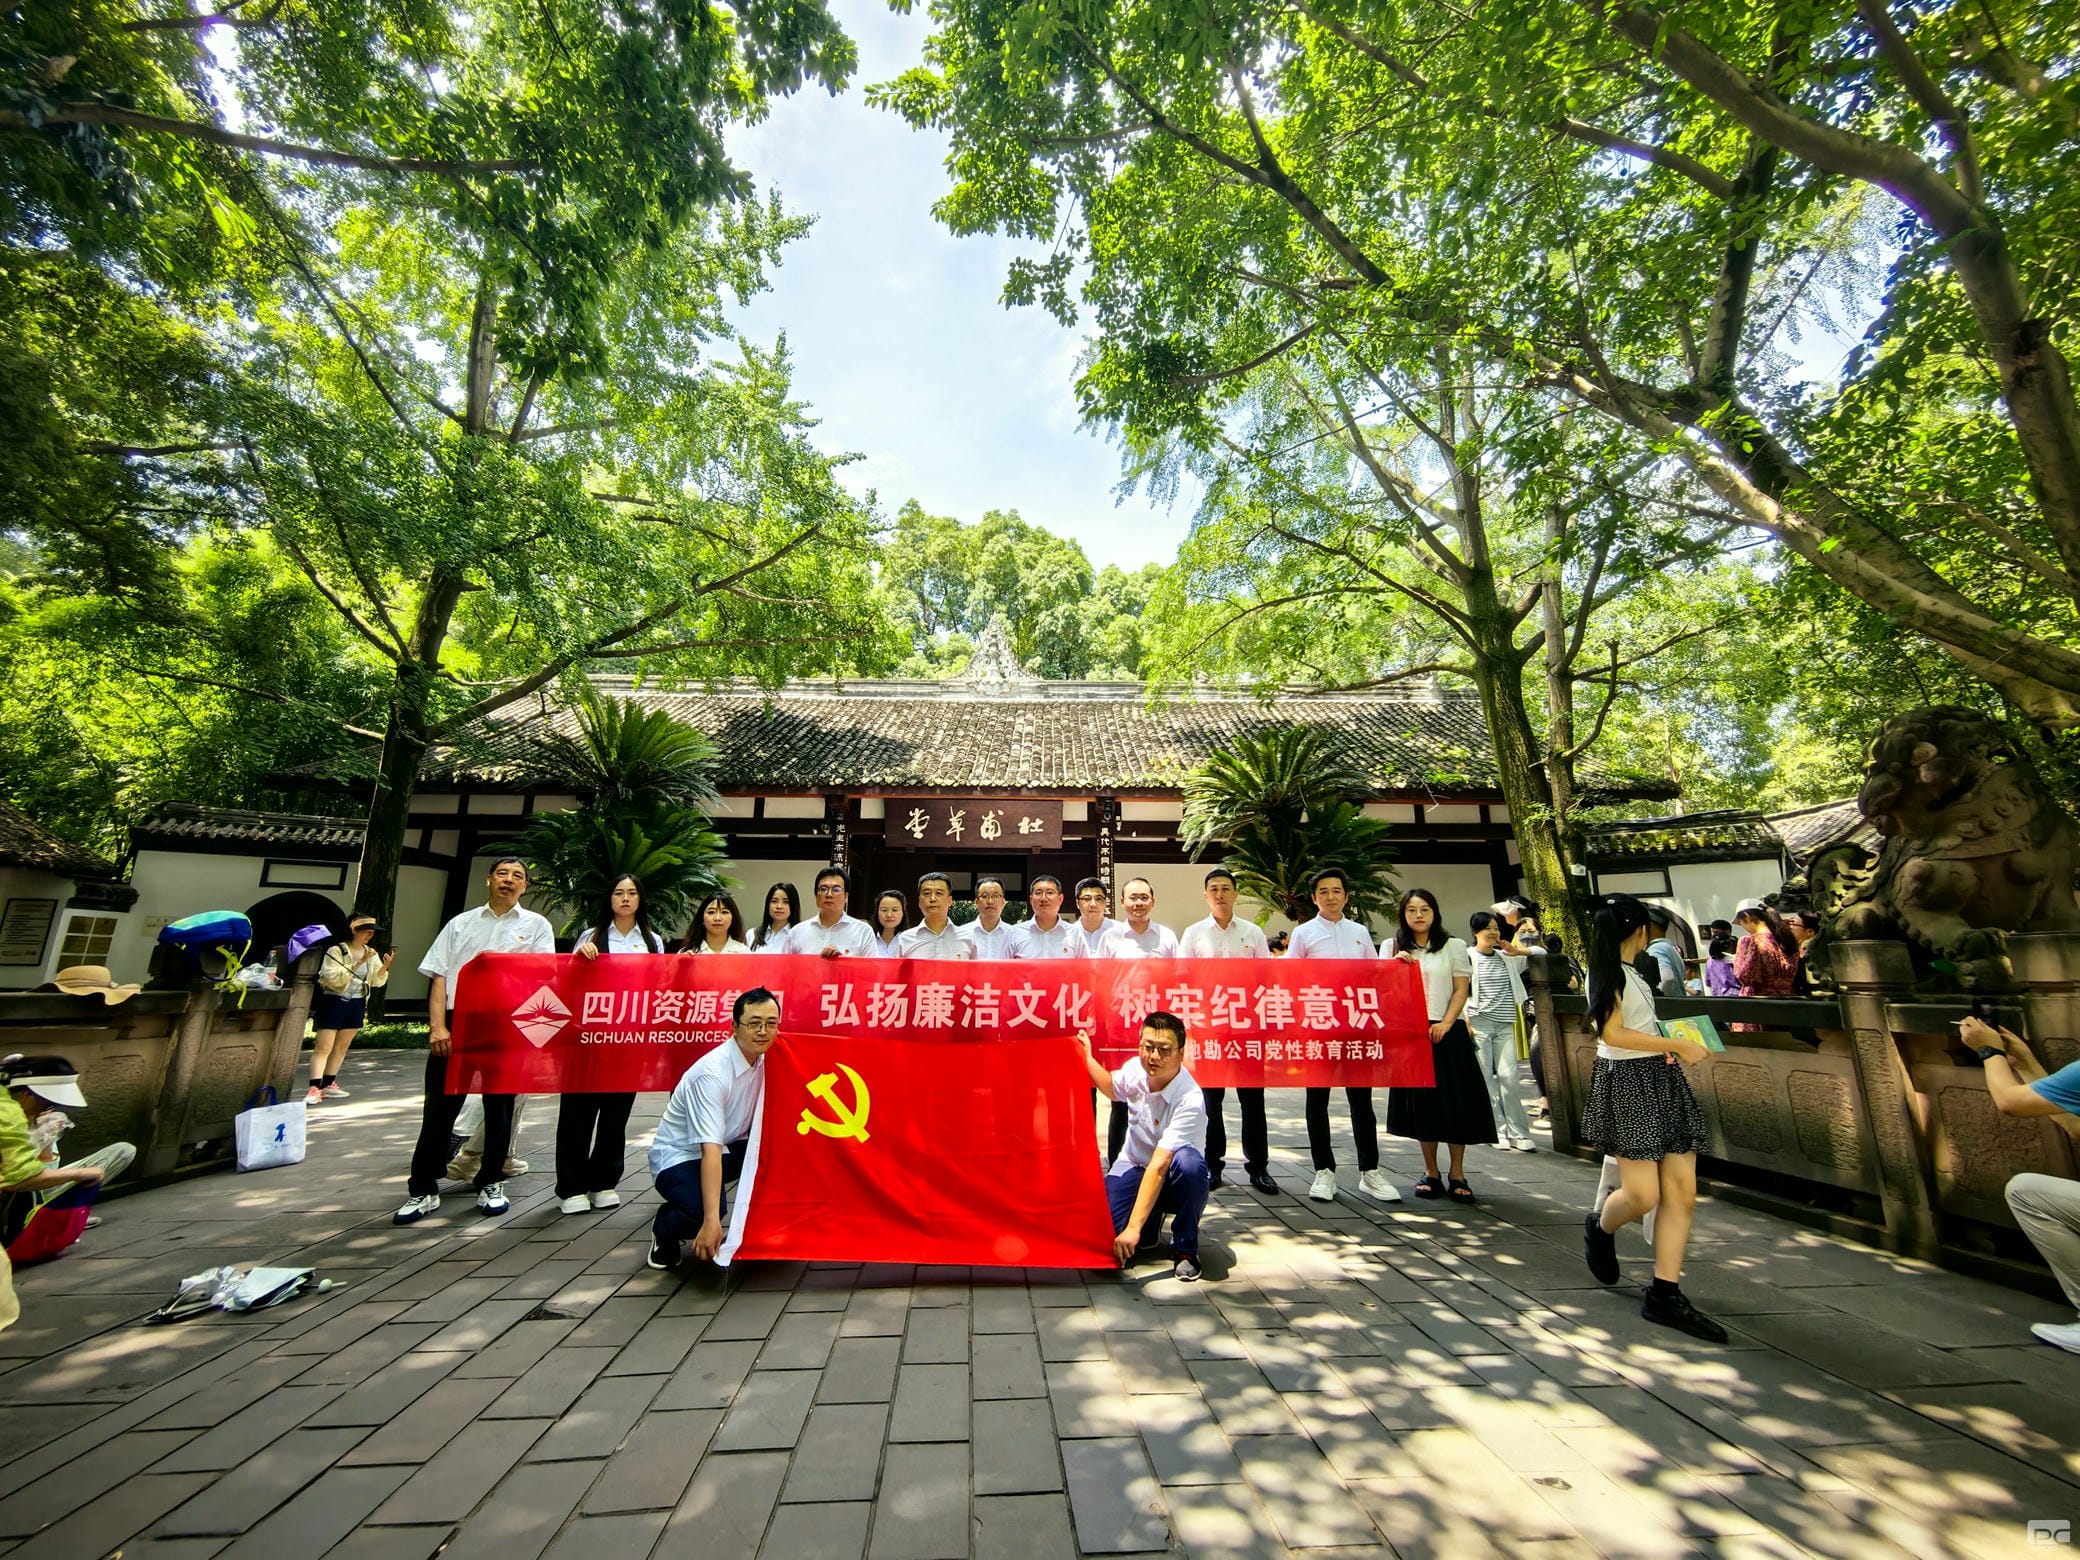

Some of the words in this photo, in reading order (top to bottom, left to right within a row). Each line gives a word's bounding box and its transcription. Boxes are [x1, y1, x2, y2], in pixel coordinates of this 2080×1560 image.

[820, 982, 1094, 1029] 弘扬廉洁文化
[1119, 983, 1386, 1031] 树牢纪律意识
[580, 1031, 645, 1044] SICHUAN
[648, 1030, 730, 1043] RESOURCES
